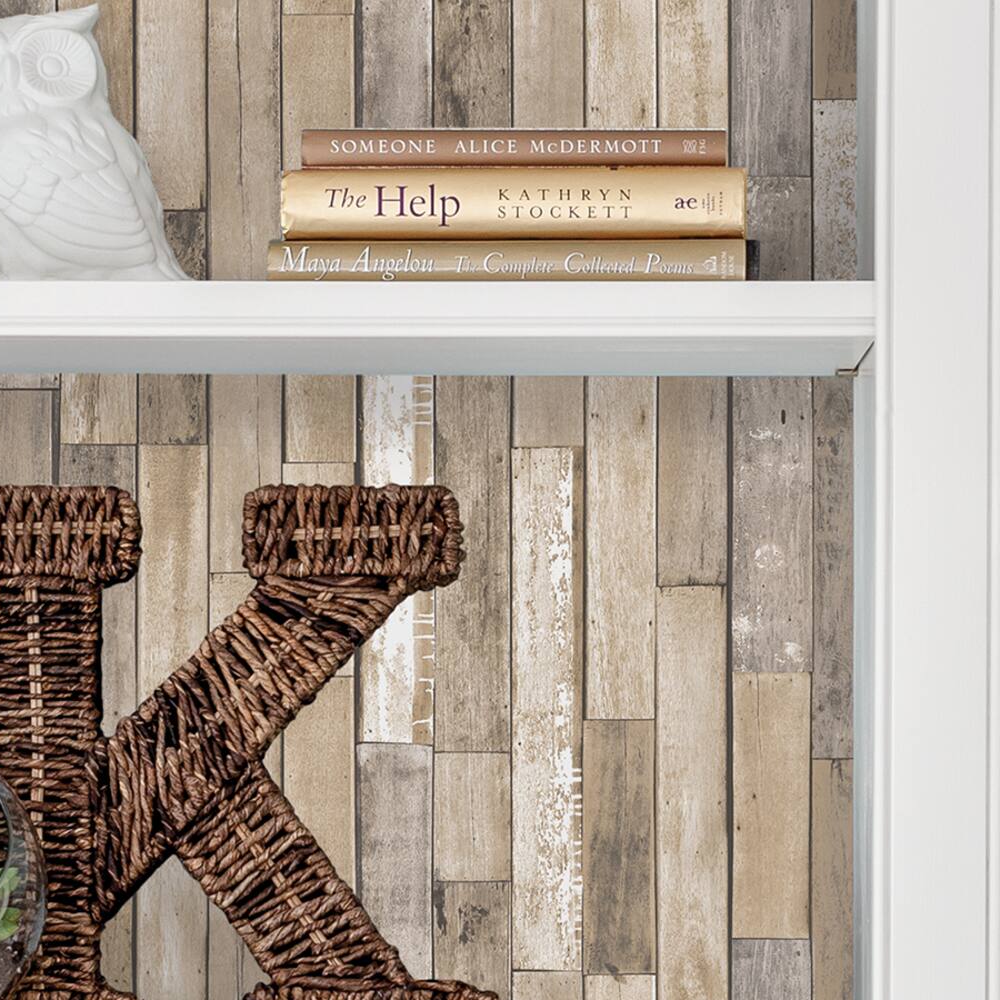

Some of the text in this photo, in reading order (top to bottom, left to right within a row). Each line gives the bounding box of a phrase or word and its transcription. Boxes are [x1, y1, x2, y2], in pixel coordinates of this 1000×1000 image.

[329, 138, 437, 154] SOMEONE
[454, 138, 662, 154] ALICE McDERMOTT
[498, 188, 632, 202] KATHRYN
[324, 183, 461, 227] The Help
[497, 205, 633, 219] STOCKETT
[279, 246, 436, 281] Maya Angelou
[454, 251, 695, 279] The Complete Collected Poems
